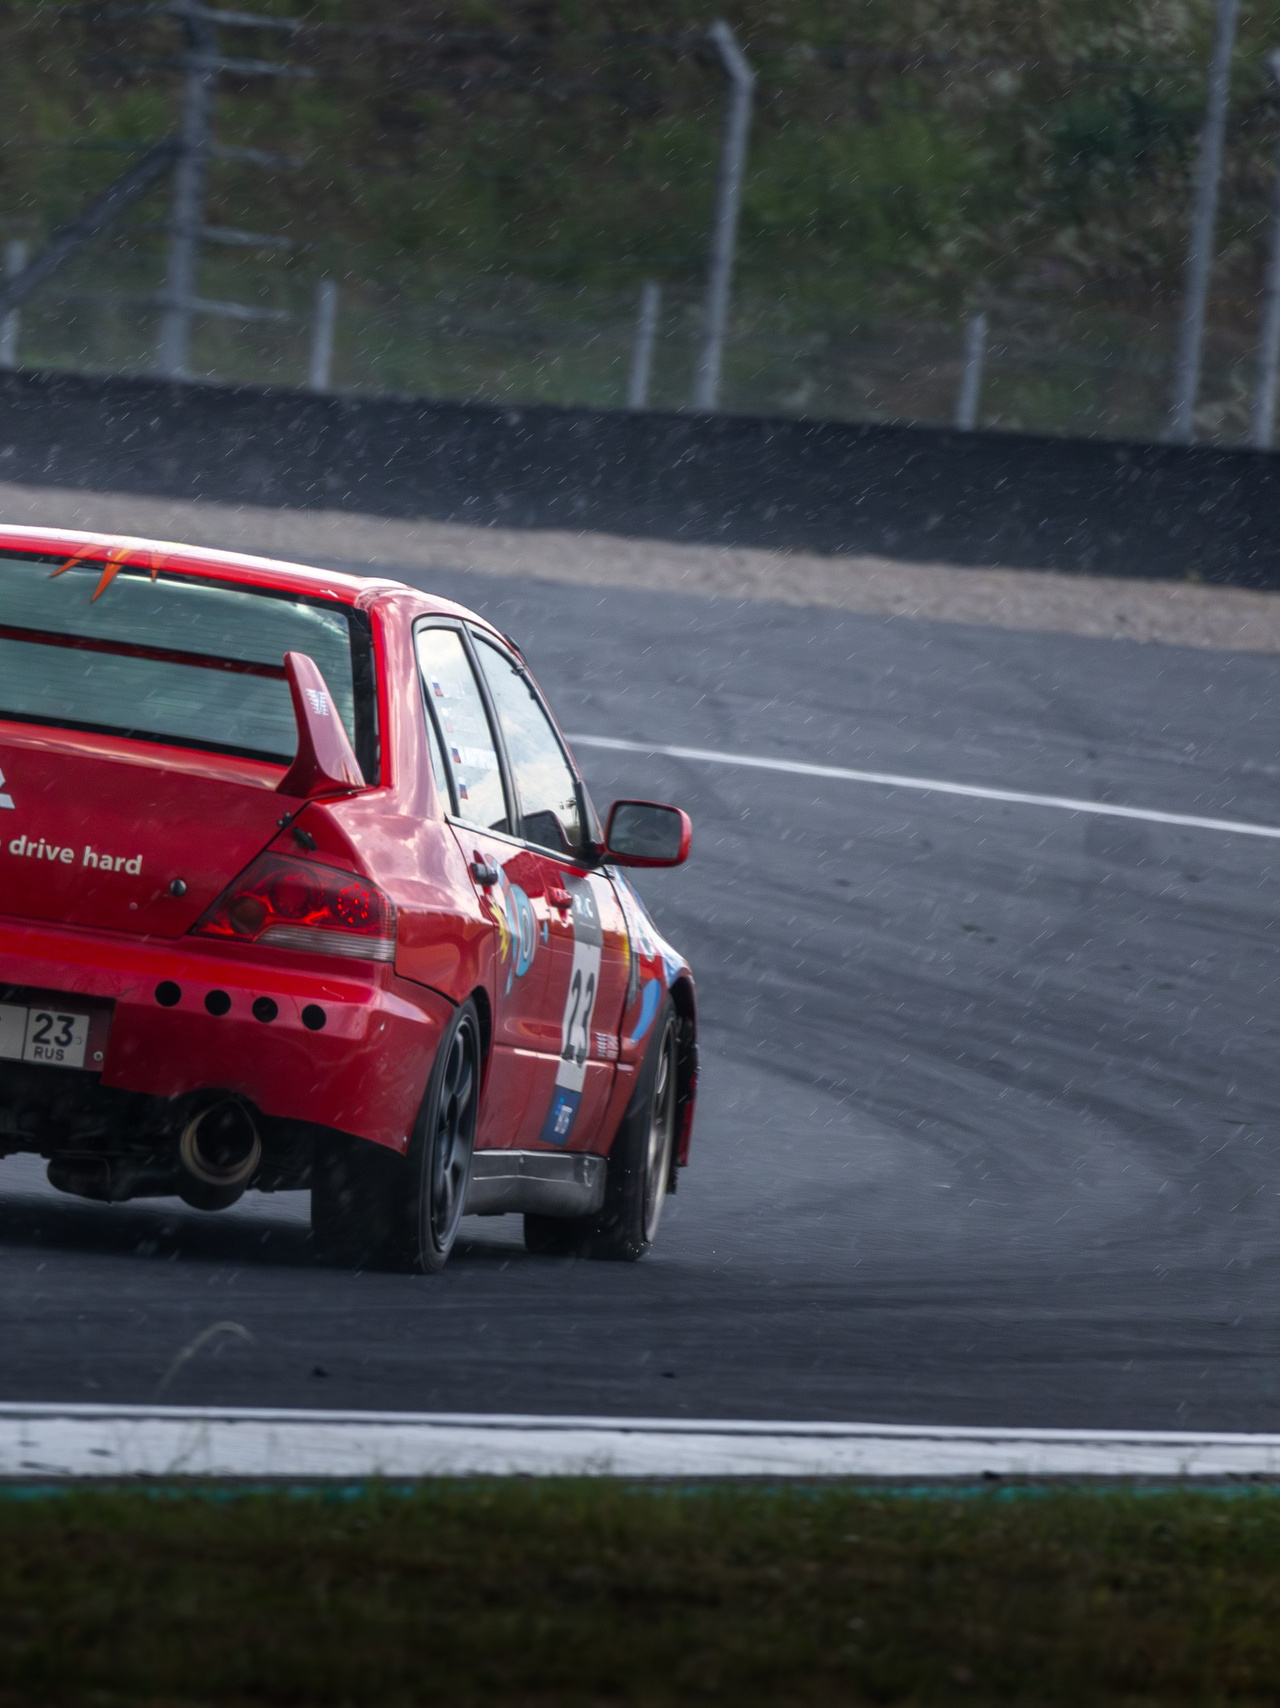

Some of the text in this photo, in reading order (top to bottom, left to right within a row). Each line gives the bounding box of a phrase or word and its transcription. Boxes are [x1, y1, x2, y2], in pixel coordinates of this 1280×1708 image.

[9, 835, 75, 863] drive
[83, 846, 143, 875] hard
[32, 1013, 75, 1047] 23
[33, 1046, 65, 1061] RUS
